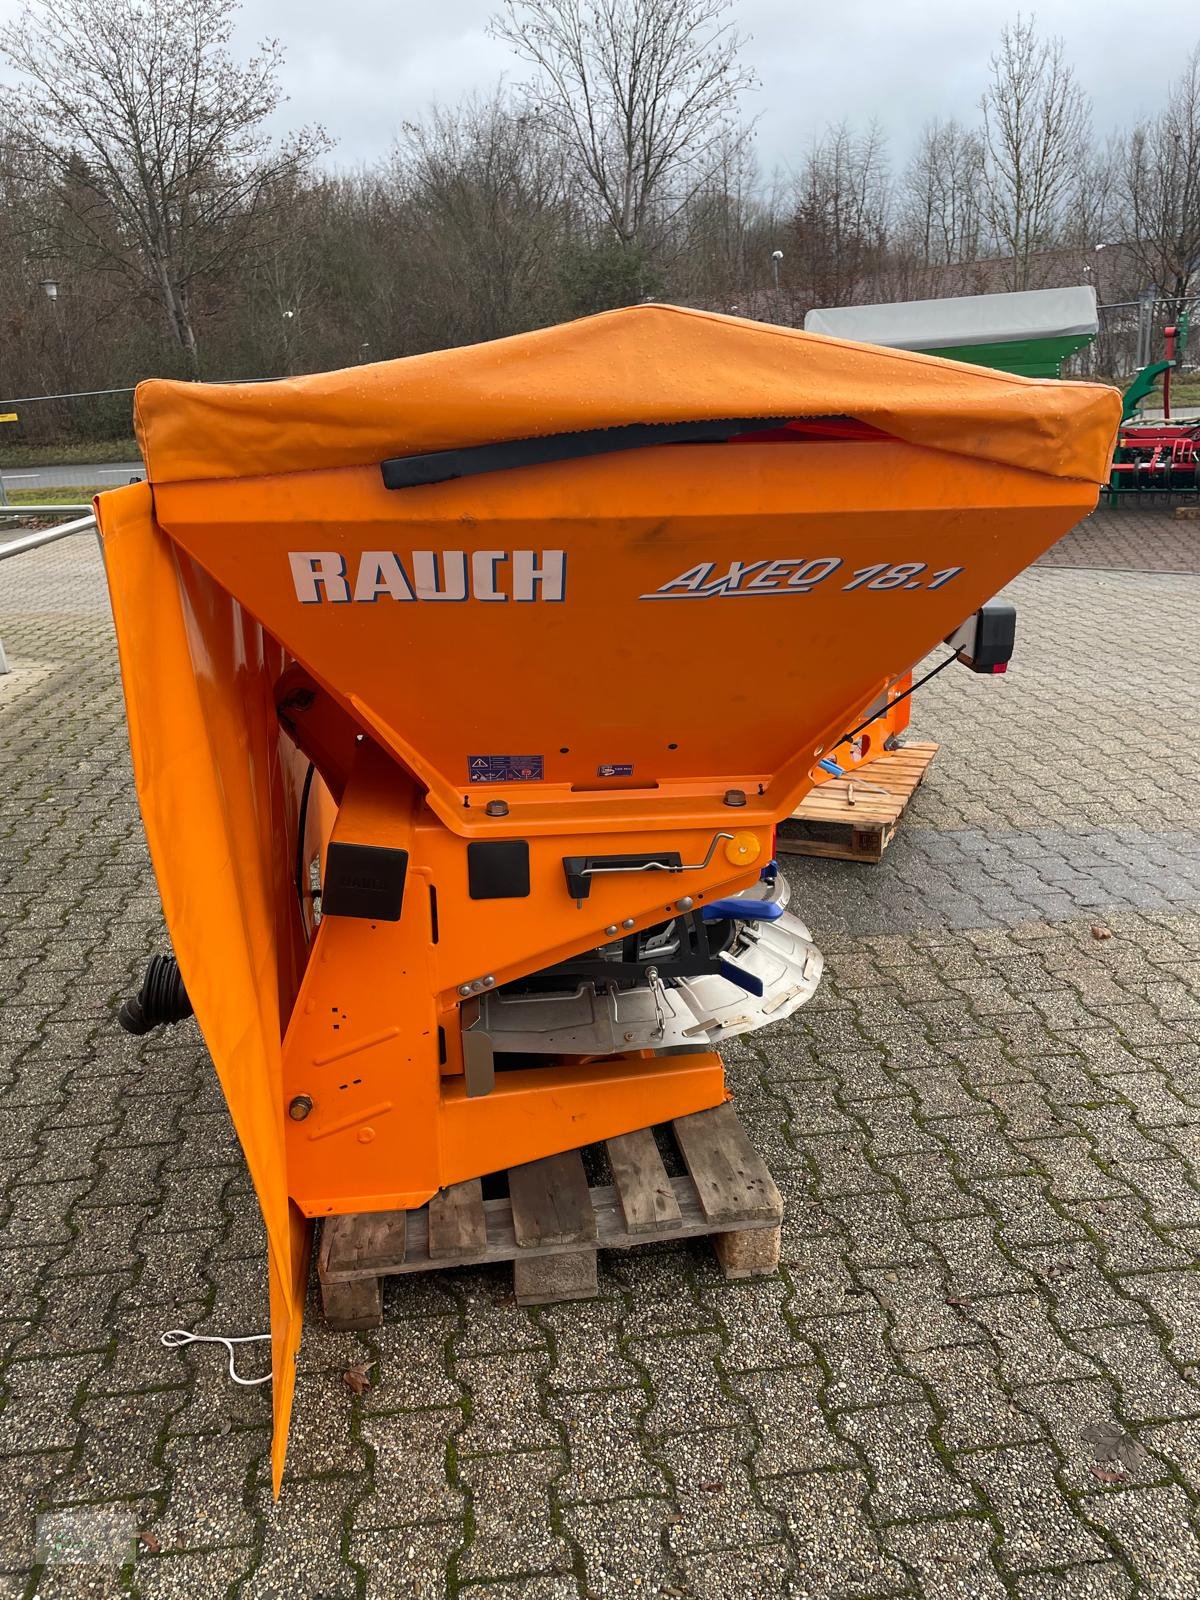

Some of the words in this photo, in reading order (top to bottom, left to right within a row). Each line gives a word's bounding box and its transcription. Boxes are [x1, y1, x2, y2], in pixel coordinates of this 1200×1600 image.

[288, 550, 566, 604] RAUCH
[655, 557, 846, 594] AXEO
[841, 562, 966, 592] 18.1
